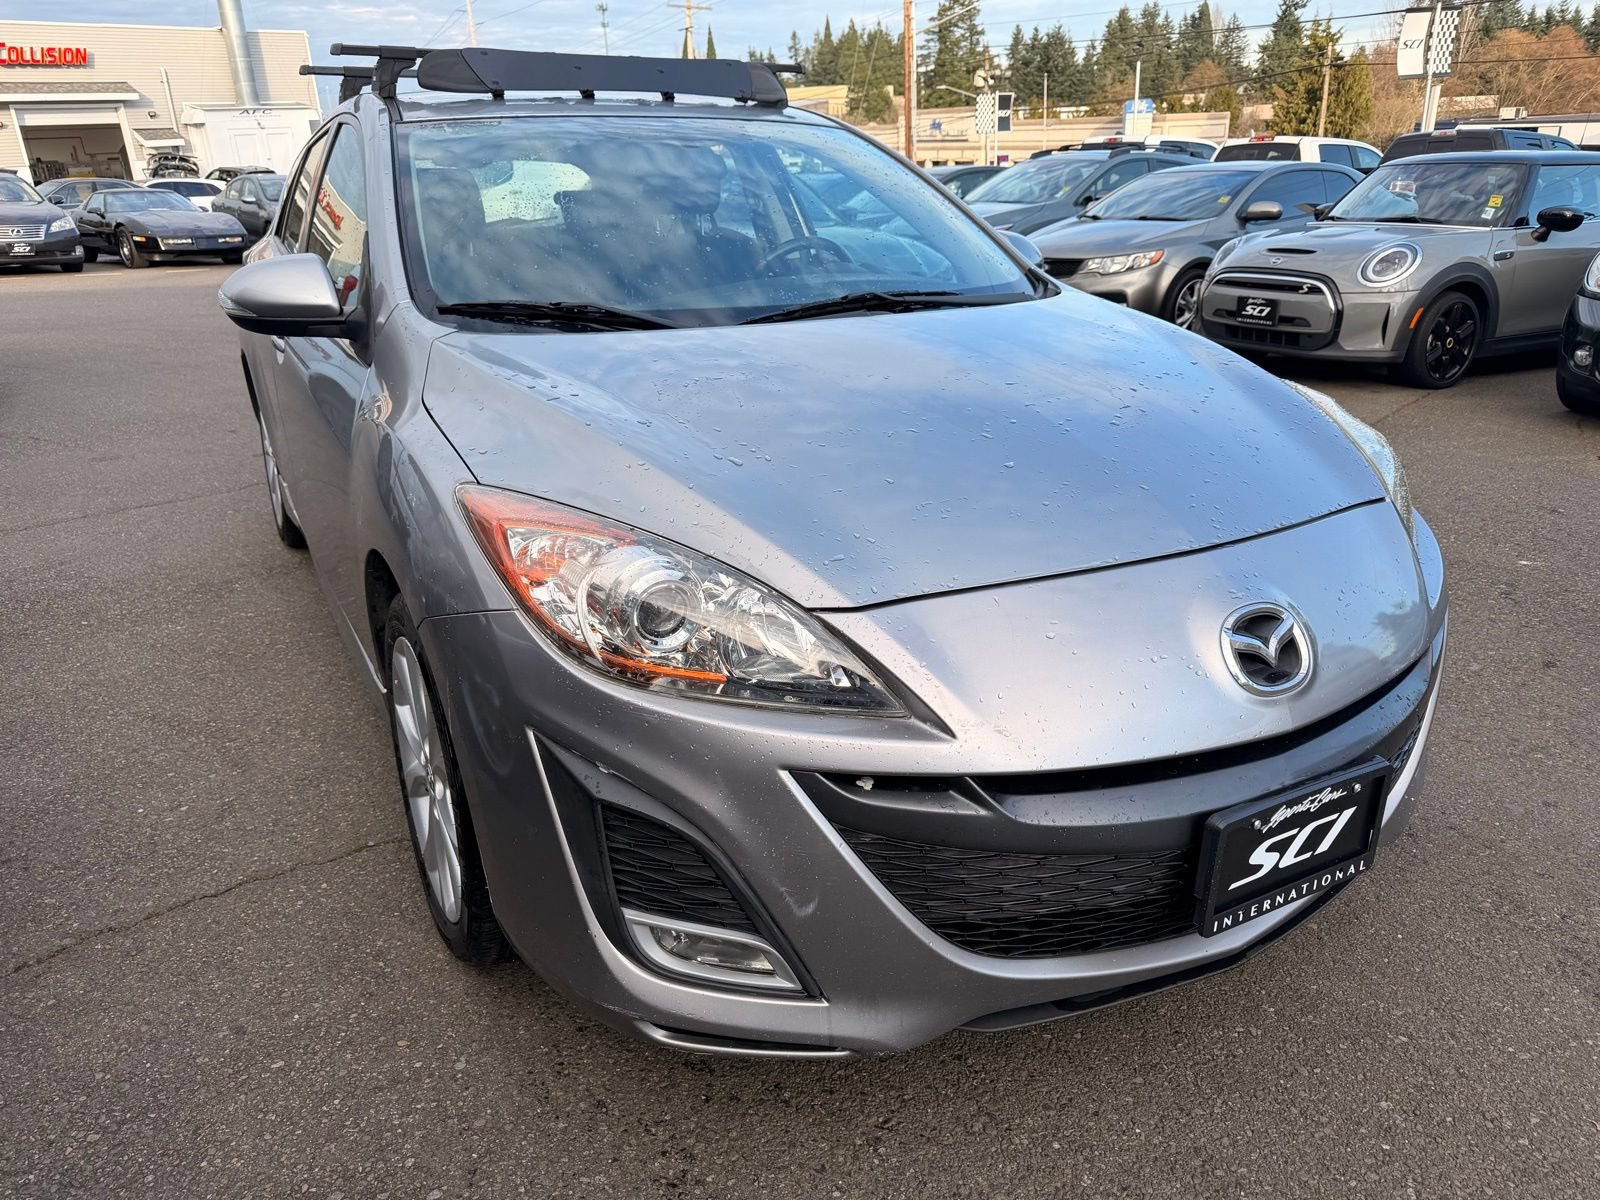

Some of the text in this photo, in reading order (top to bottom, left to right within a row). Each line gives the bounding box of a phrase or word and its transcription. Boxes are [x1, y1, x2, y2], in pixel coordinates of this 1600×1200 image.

[1399, 38, 1425, 49] SCI
[1298, 283, 1312, 294] S
[1241, 305, 1272, 317] SCI
[1261, 787, 1348, 834] Sports Cars
[1228, 806, 1358, 891] SCI
[1212, 860, 1367, 932] INTERNATIONAL
